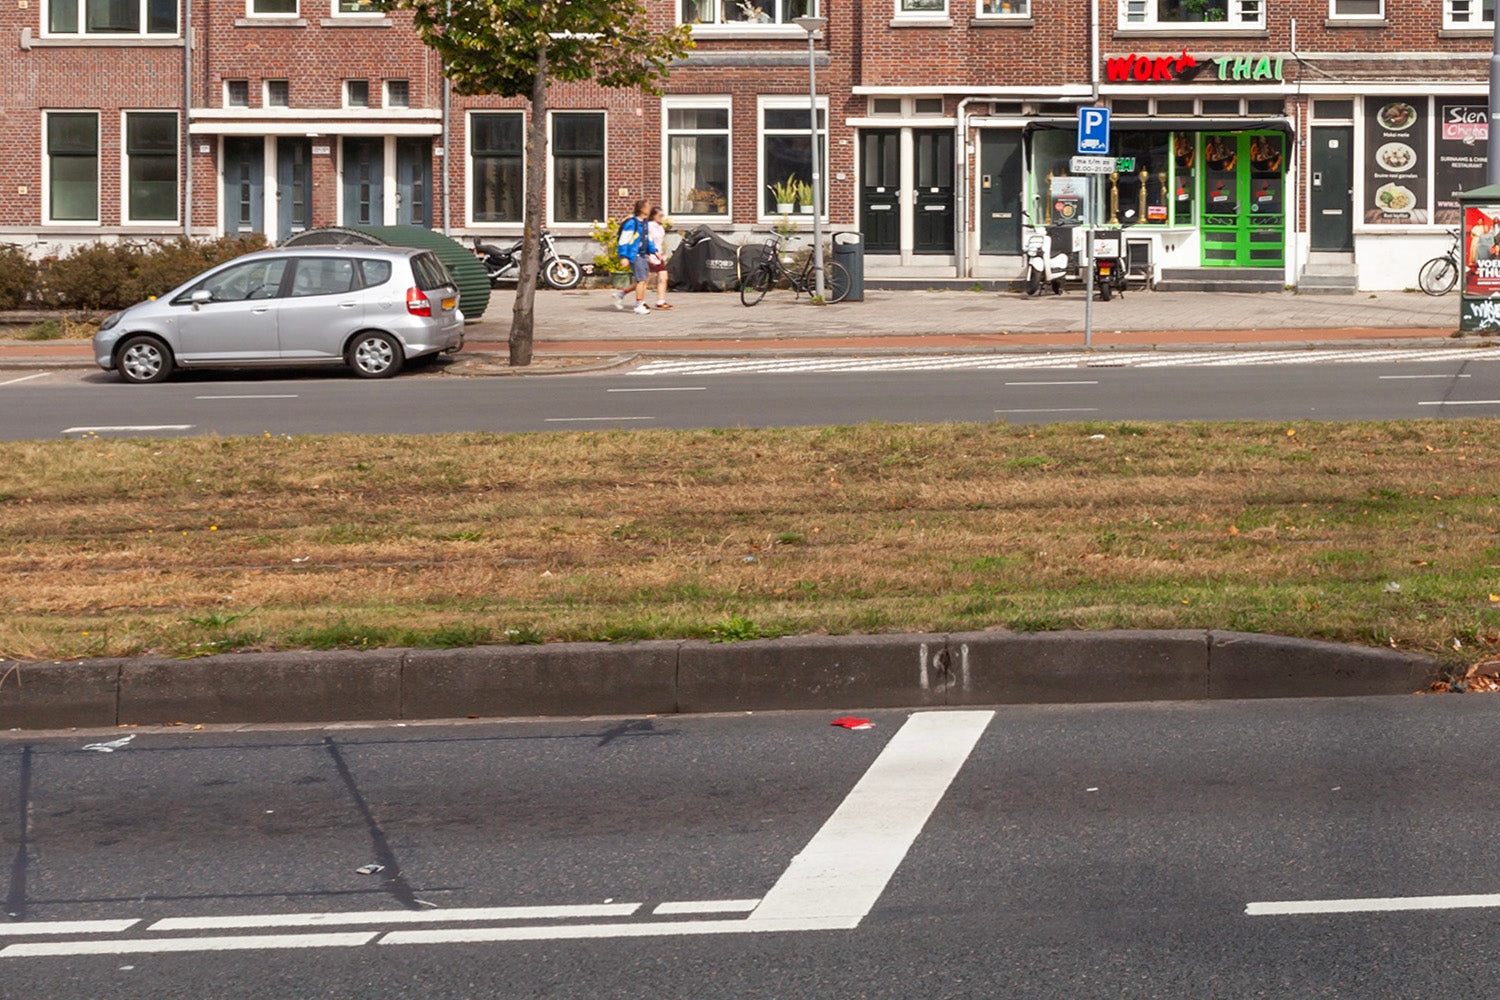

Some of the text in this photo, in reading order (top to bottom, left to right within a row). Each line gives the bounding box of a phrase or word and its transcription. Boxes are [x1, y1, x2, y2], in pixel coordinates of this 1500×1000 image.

[1106, 53, 1284, 82] WOK THAI
[1085, 111, 1103, 135] P
[1447, 106, 1488, 124] Sien
